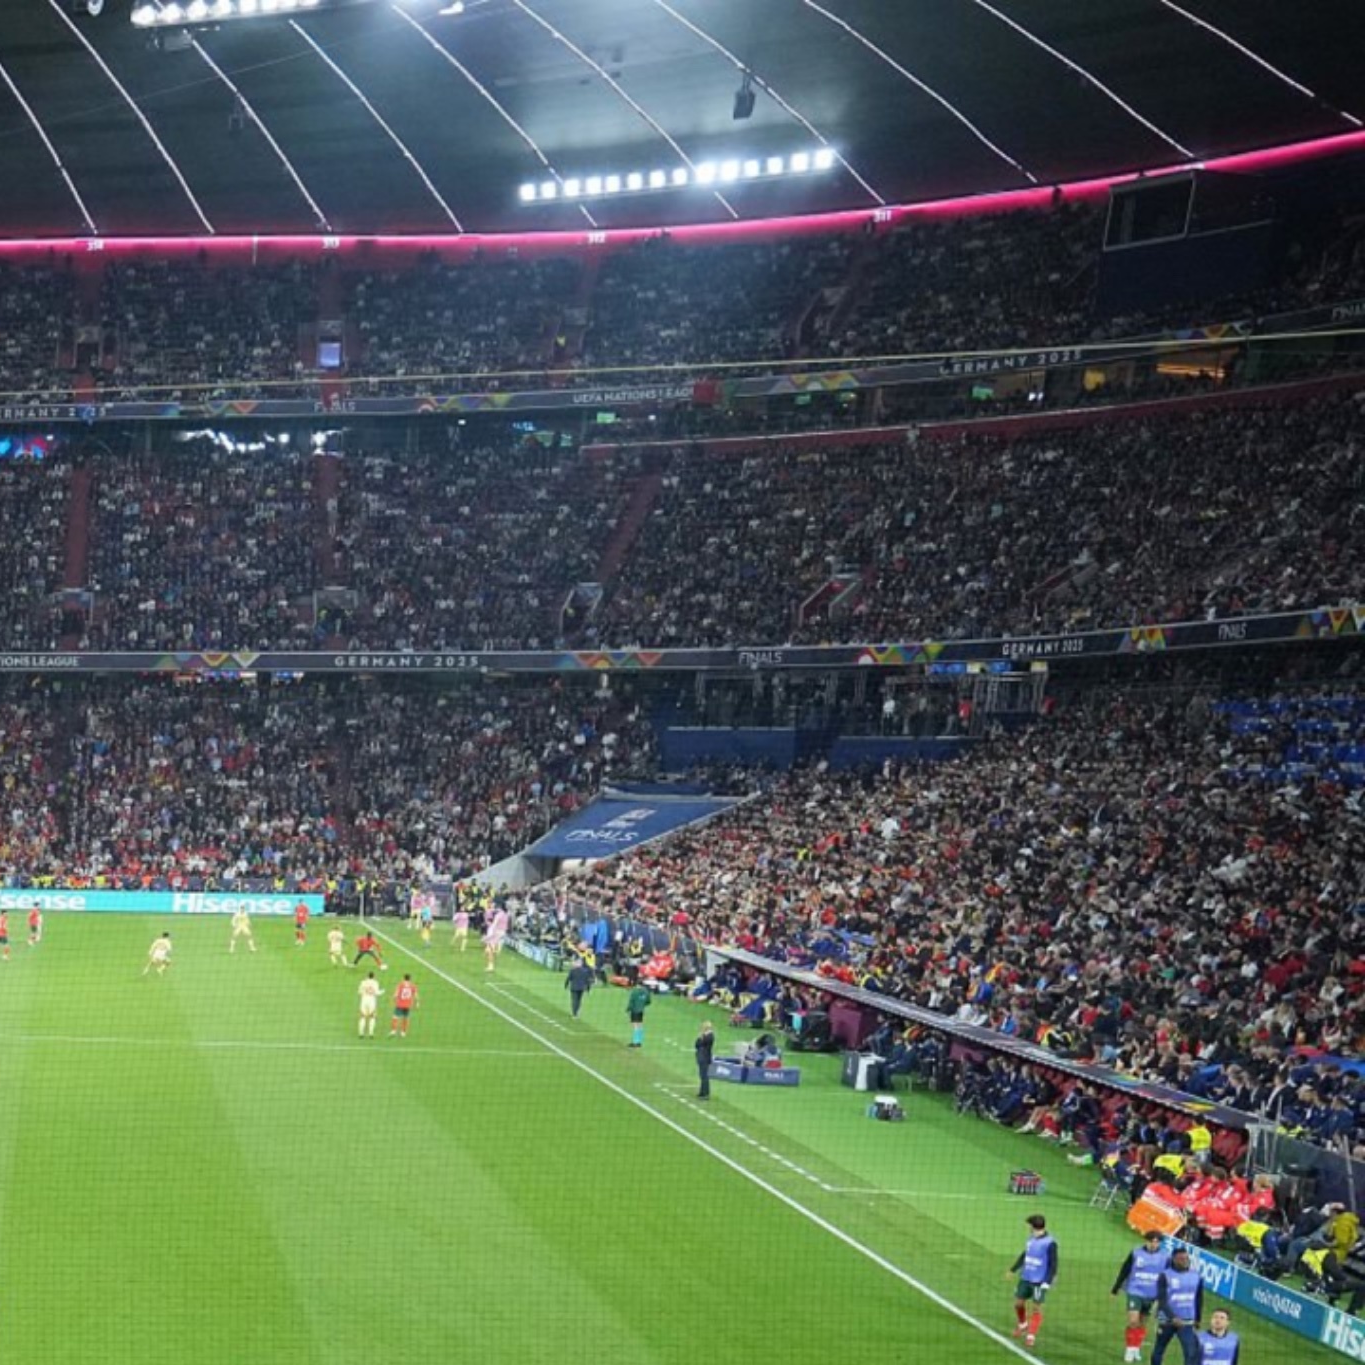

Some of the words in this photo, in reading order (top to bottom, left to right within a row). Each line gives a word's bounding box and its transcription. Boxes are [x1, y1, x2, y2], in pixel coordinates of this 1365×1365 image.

[573, 393, 602, 403] UEFA
[604, 390, 656, 401] NATIONS
[32, 656, 79, 667] LEAGUE
[335, 656, 423, 667] GERMANY
[434, 656, 478, 667] 2025
[739, 651, 783, 665] FINALS
[565, 829, 639, 842] FINALS
[172, 893, 291, 914] Hisense
